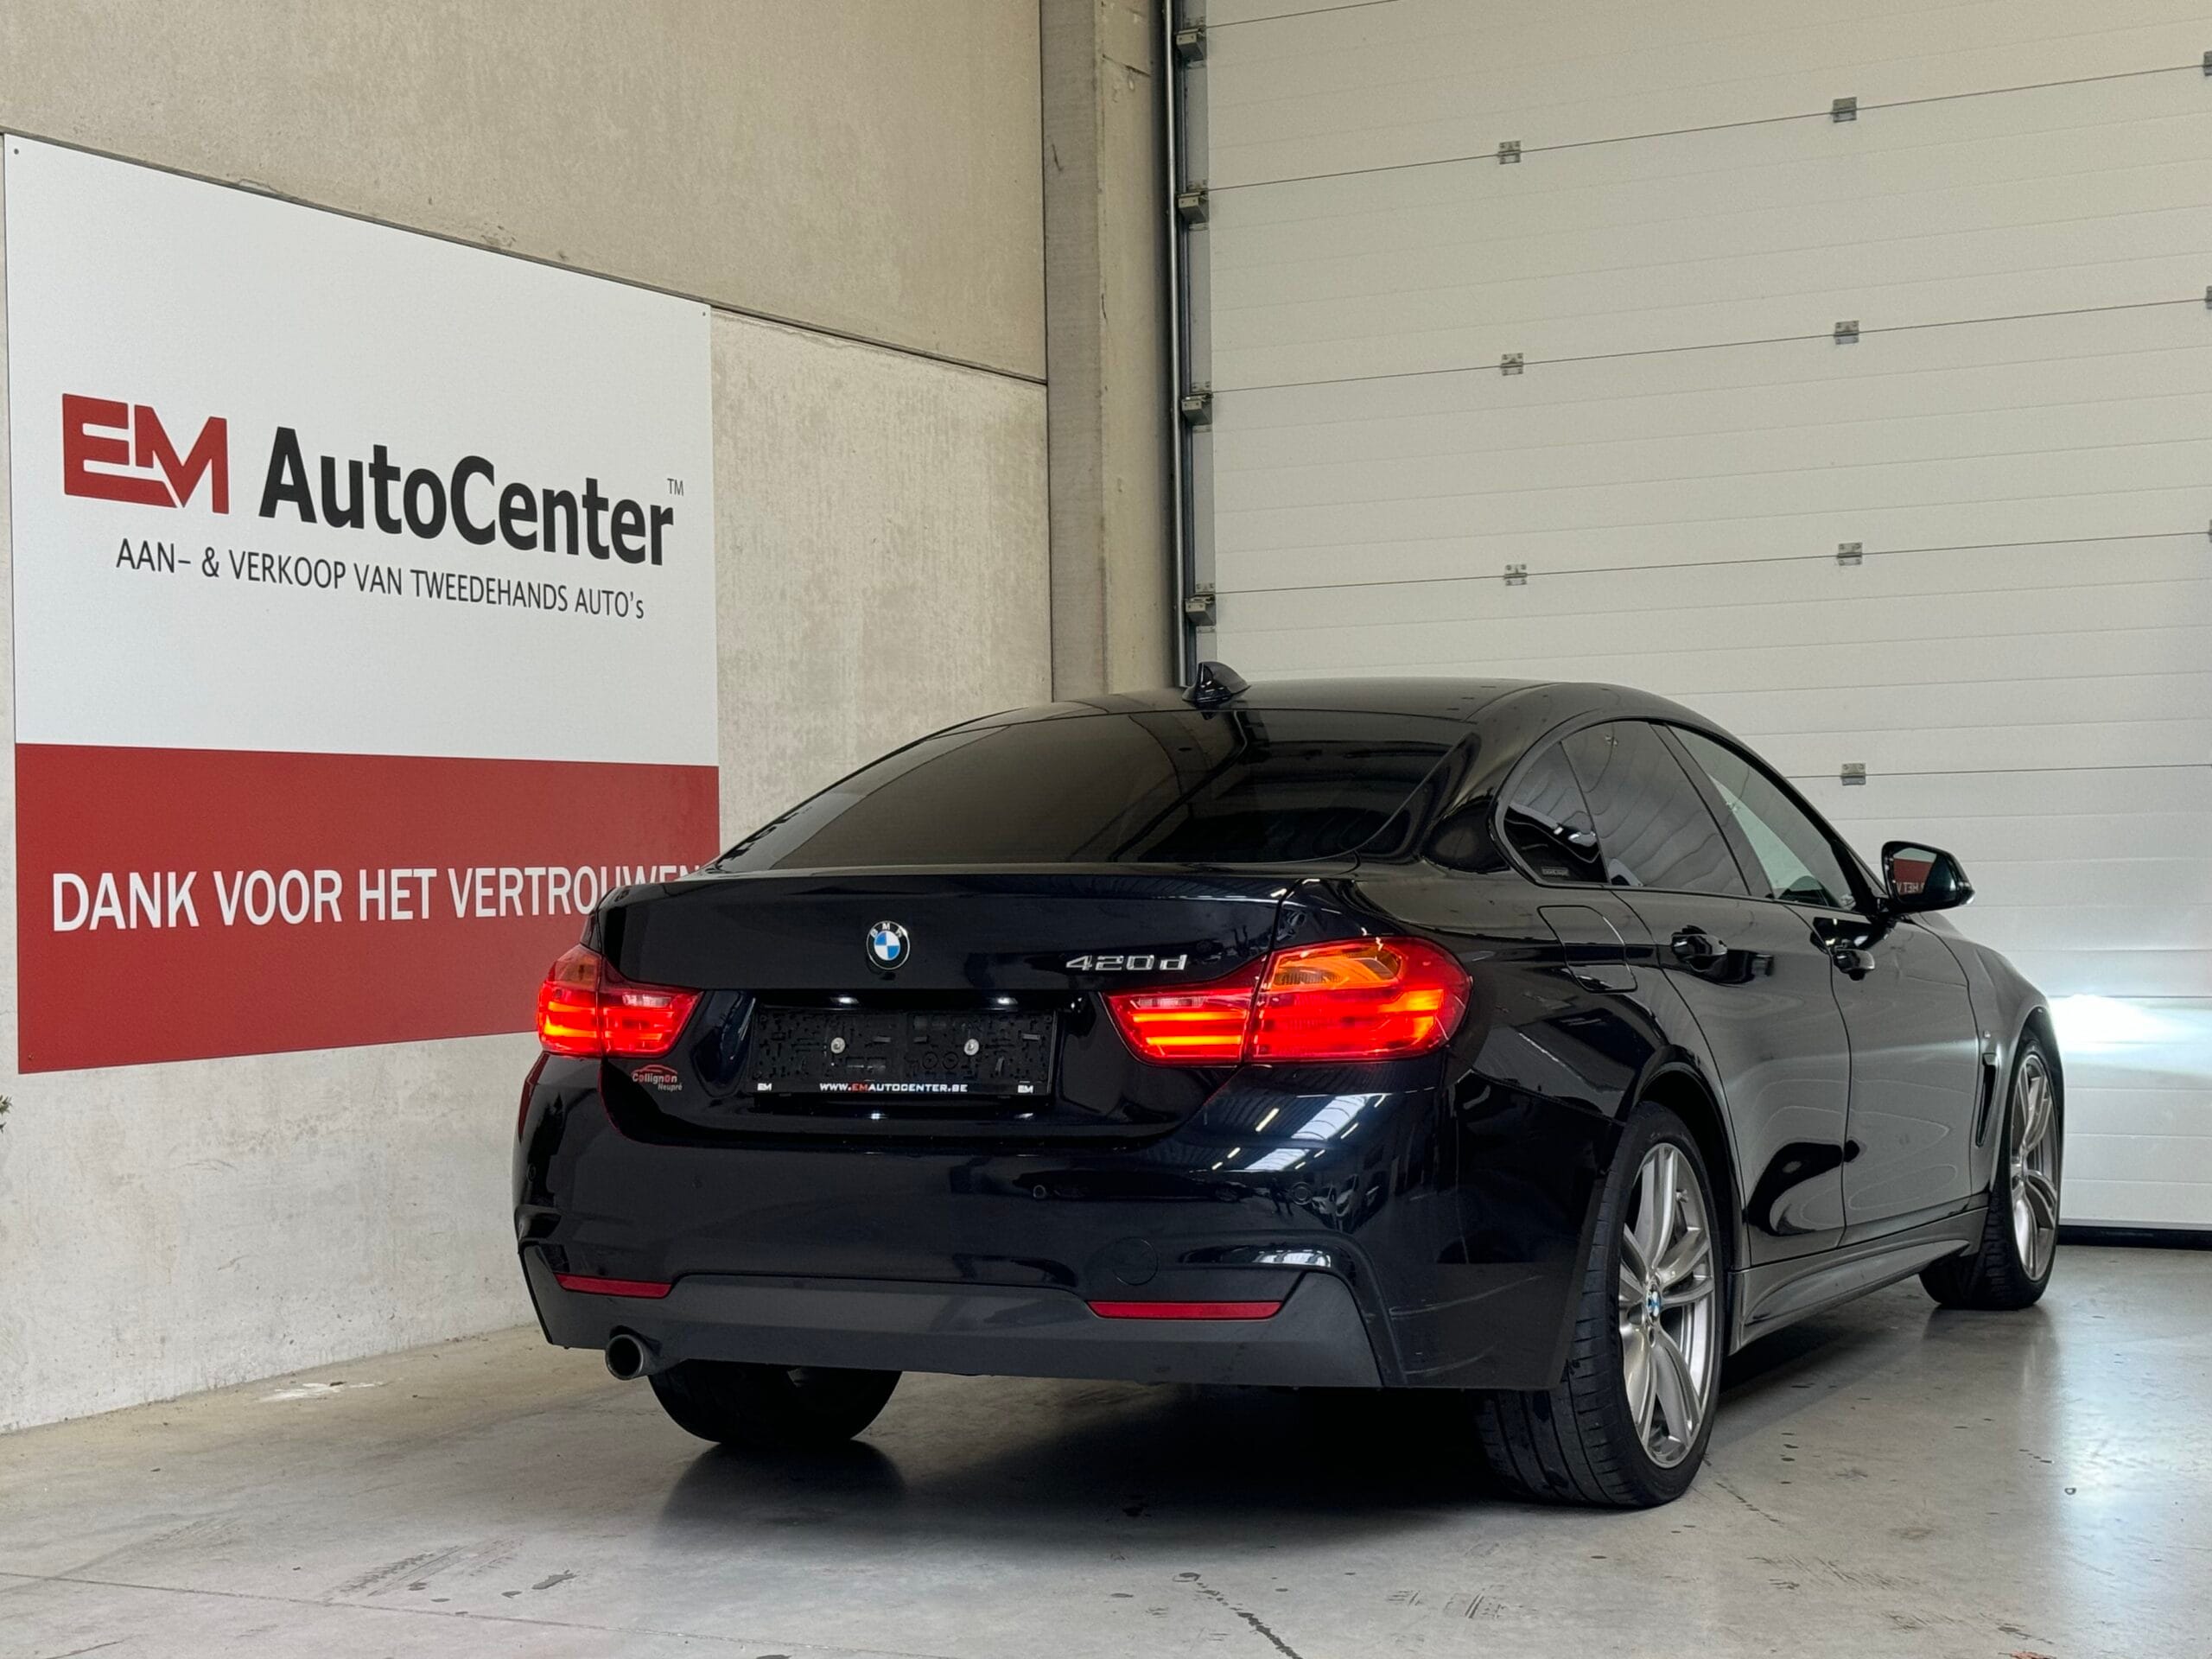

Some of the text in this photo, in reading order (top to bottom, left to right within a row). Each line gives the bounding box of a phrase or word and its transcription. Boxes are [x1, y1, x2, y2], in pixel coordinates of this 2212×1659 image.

[63, 395, 229, 514] EM
[259, 427, 673, 565] AutoCenter
[117, 538, 191, 573] AAN-
[201, 546, 219, 577] &
[229, 550, 346, 589] VERKOOP
[354, 563, 402, 595] VAN
[410, 569, 569, 613] TWEEDEHANDS
[54, 865, 701, 931] DANK VOOR HET VERTRO
[1065, 954, 1187, 970] 420d
[632, 1072, 677, 1084] Collignon
